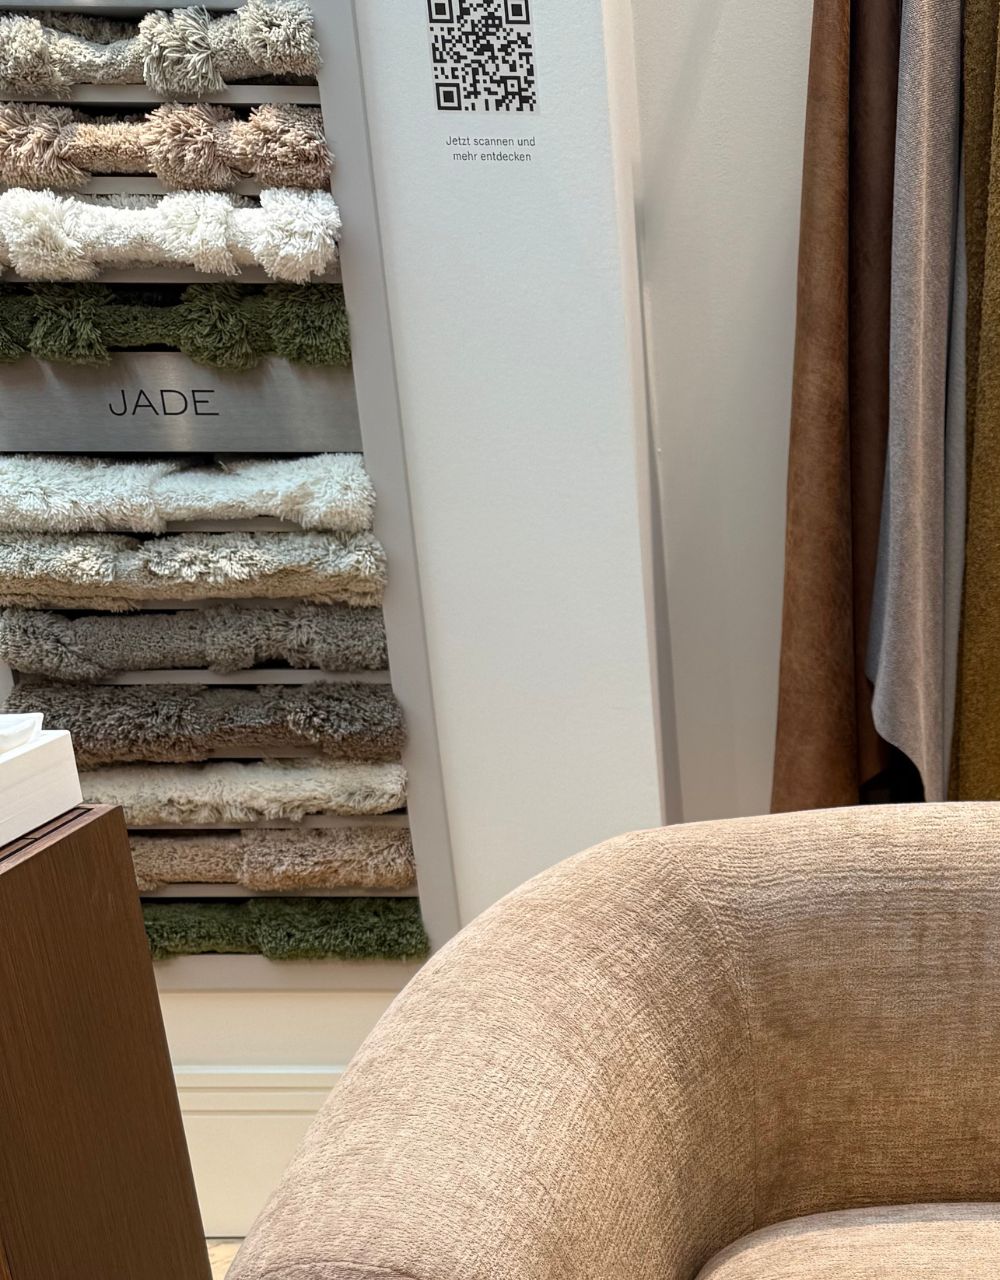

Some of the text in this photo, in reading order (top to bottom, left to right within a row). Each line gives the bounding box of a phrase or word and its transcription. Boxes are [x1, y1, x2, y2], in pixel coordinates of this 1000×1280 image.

[446, 136, 536, 147] Jetzt scannen und
[453, 151, 532, 161] mehr entdecken
[108, 389, 220, 416] JADE
